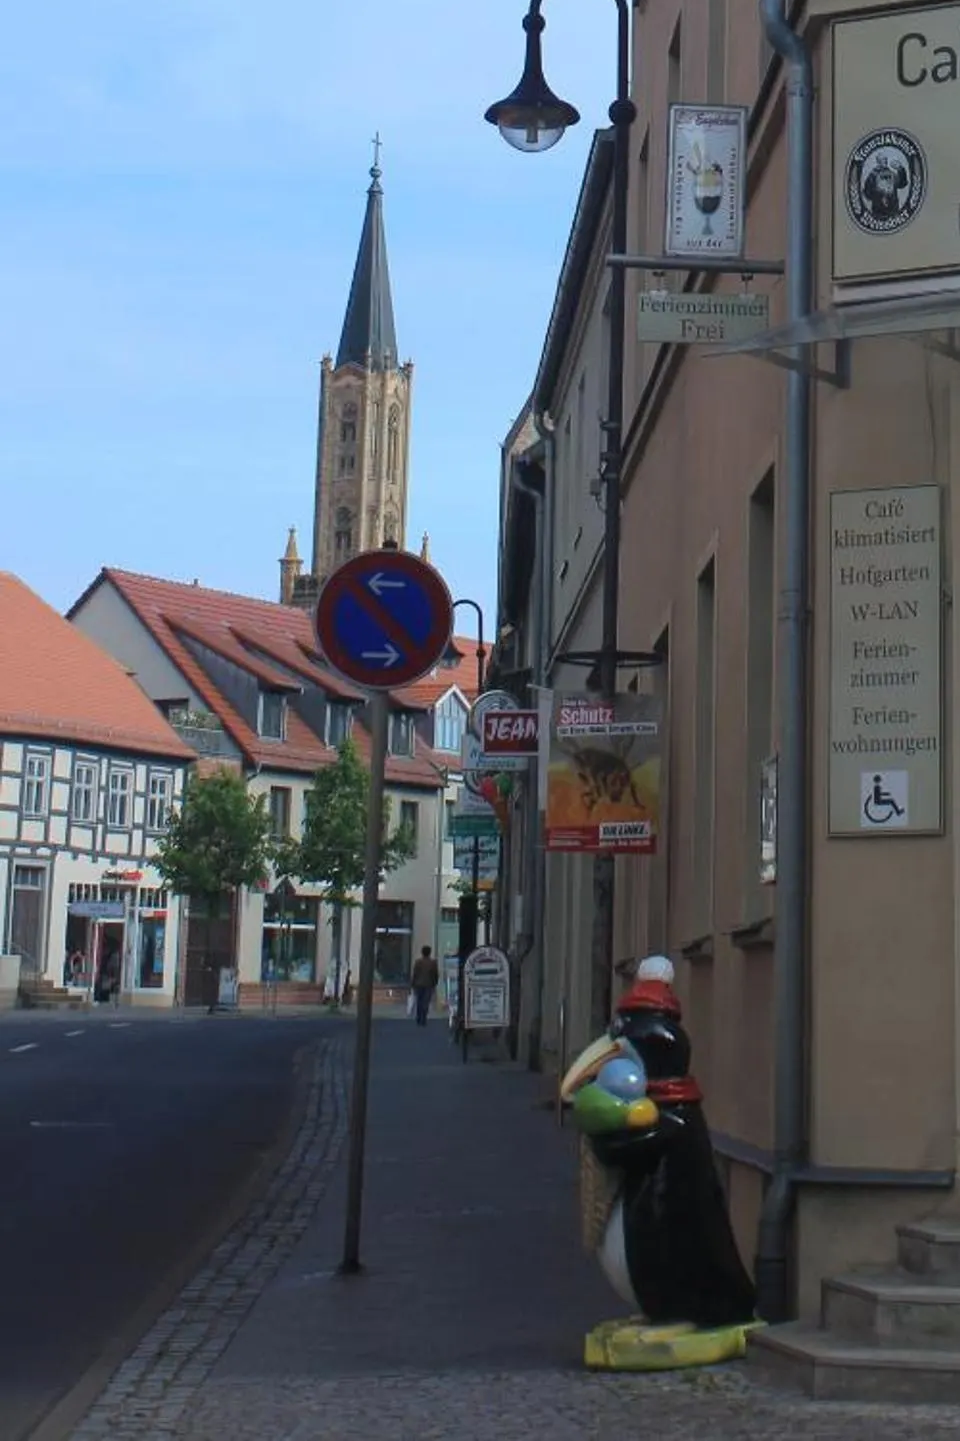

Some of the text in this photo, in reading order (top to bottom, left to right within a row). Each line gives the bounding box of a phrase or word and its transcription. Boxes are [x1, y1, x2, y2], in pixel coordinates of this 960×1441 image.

[679, 318, 725, 340] Frei
[864, 500, 904, 520] Café
[833, 525, 936, 550] klimatisiert
[839, 563, 930, 589] Hofgarten
[851, 600, 920, 622] W-LAN
[852, 640, 918, 659] Ferien-
[850, 668, 920, 689] zimmer
[560, 707, 613, 725] Schutz
[852, 706, 918, 727] Ferien-
[832, 733, 937, 757] wohnungen
